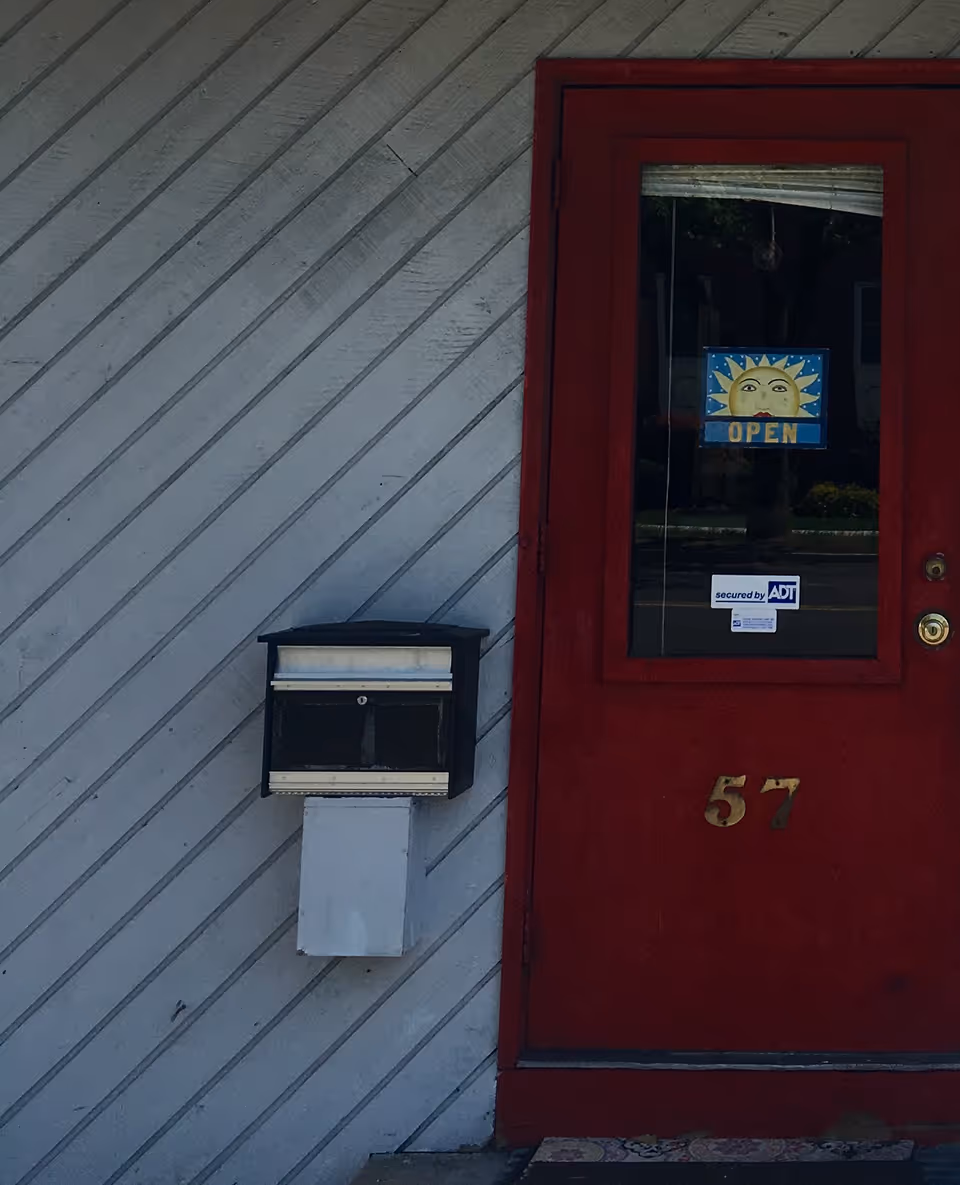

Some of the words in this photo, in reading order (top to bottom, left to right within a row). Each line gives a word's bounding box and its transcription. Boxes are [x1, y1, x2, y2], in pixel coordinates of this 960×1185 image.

[728, 421, 798, 444] OPEN
[715, 591, 753, 599] secured
[754, 591, 766, 601] by
[768, 584, 797, 600] ADT
[704, 775, 801, 830] 57
